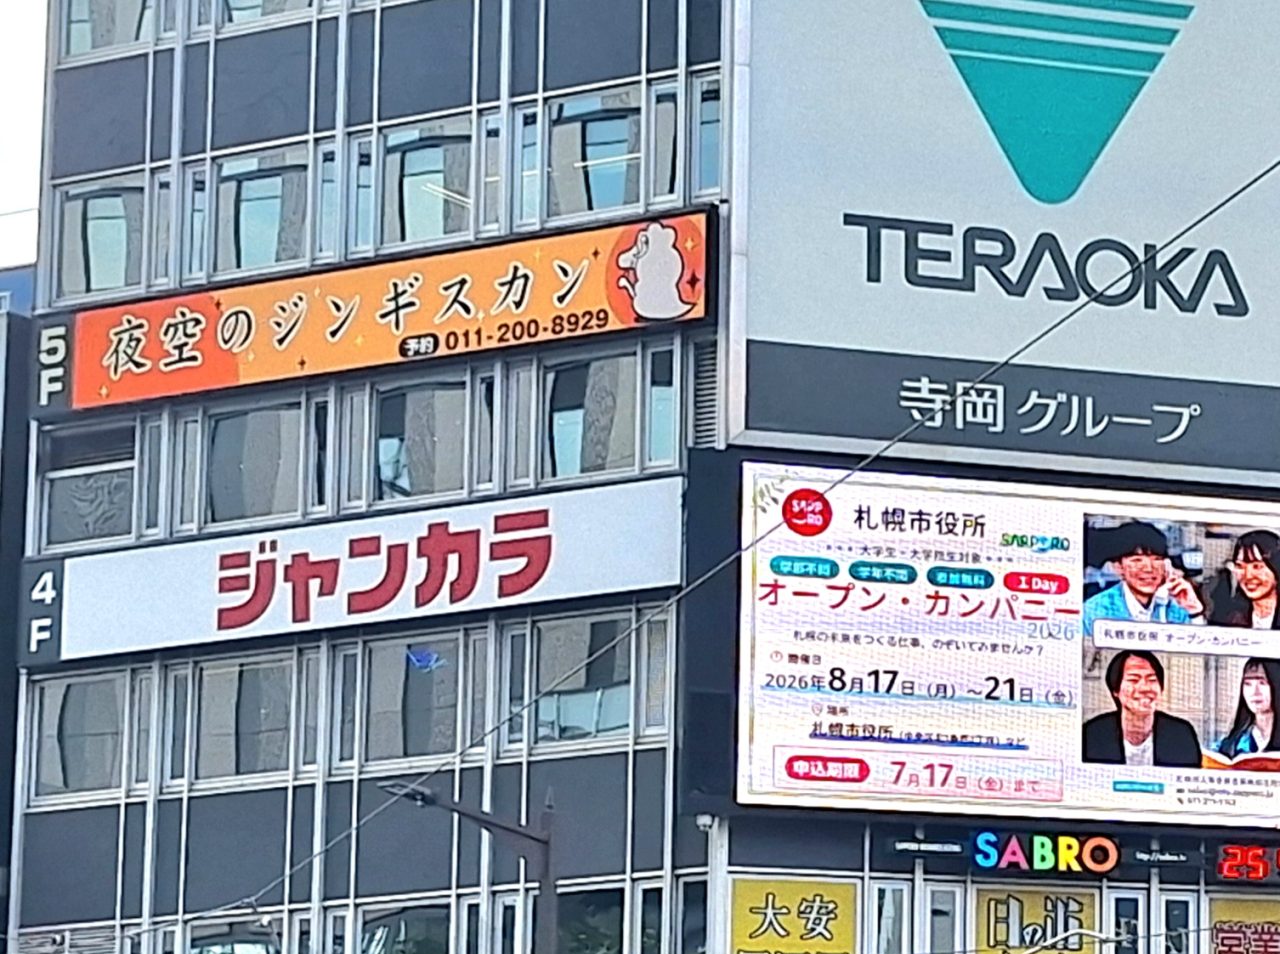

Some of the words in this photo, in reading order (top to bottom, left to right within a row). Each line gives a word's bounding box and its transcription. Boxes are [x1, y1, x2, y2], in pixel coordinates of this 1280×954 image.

[843, 212, 1249, 318] TERAOKA
[103, 257, 591, 379] 夜空のジンギスカン
[444, 308, 609, 350] 011-200-8929
[853, 504, 986, 539] 札幌市役所
[217, 508, 553, 631] ジャンカラ
[758, 579, 1081, 622] オープン・カンパニー
[975, 831, 1119, 873] SABRO
[750, 891, 839, 941] 大安
